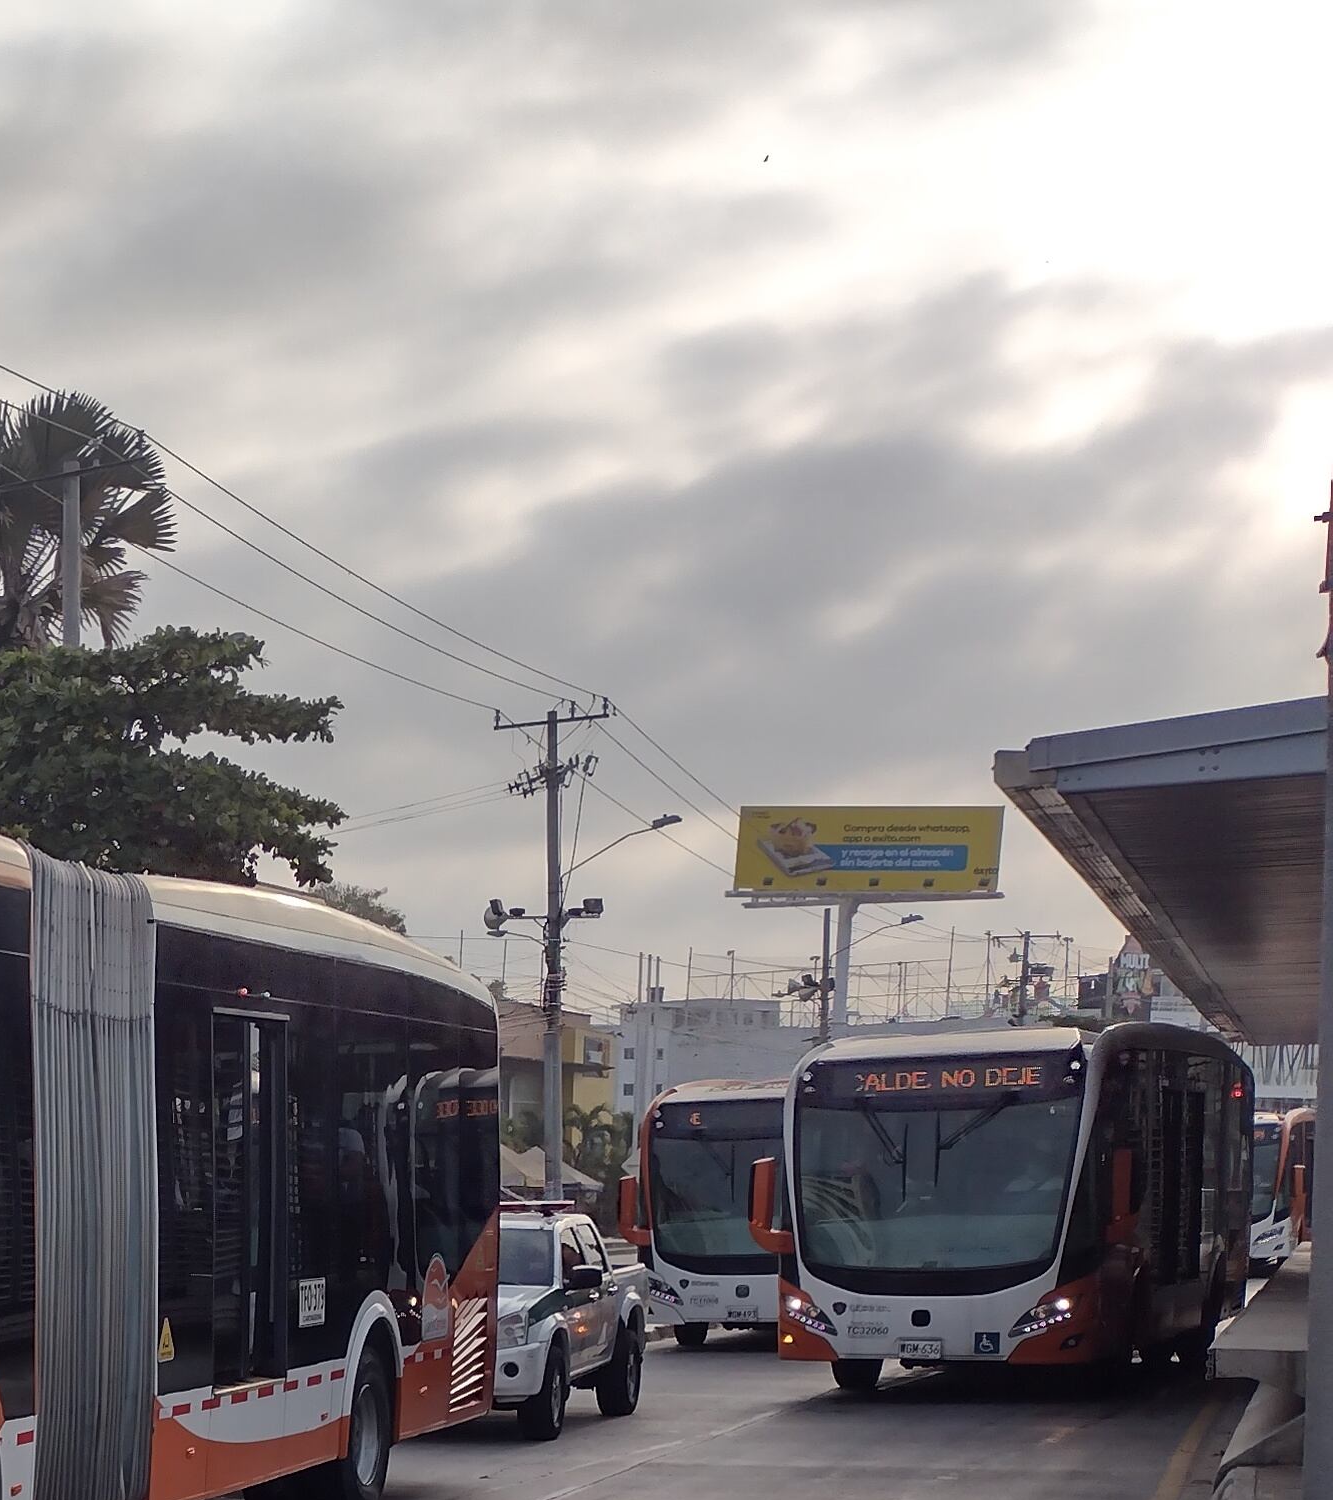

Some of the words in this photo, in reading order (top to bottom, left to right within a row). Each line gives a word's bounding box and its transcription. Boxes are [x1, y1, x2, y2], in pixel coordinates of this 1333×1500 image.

[843, 823, 885, 834] Compra
[886, 823, 917, 833] desde
[842, 835, 863, 844] app
[849, 849, 884, 859] recoge
[885, 849, 899, 857] en
[900, 848, 909, 857] el
[839, 858, 855, 867] sin
[856, 858, 894, 869] bajarte
[895, 858, 911, 868] del
[940, 1068, 976, 1089] NO
[984, 1065, 1043, 1087] DEJE
